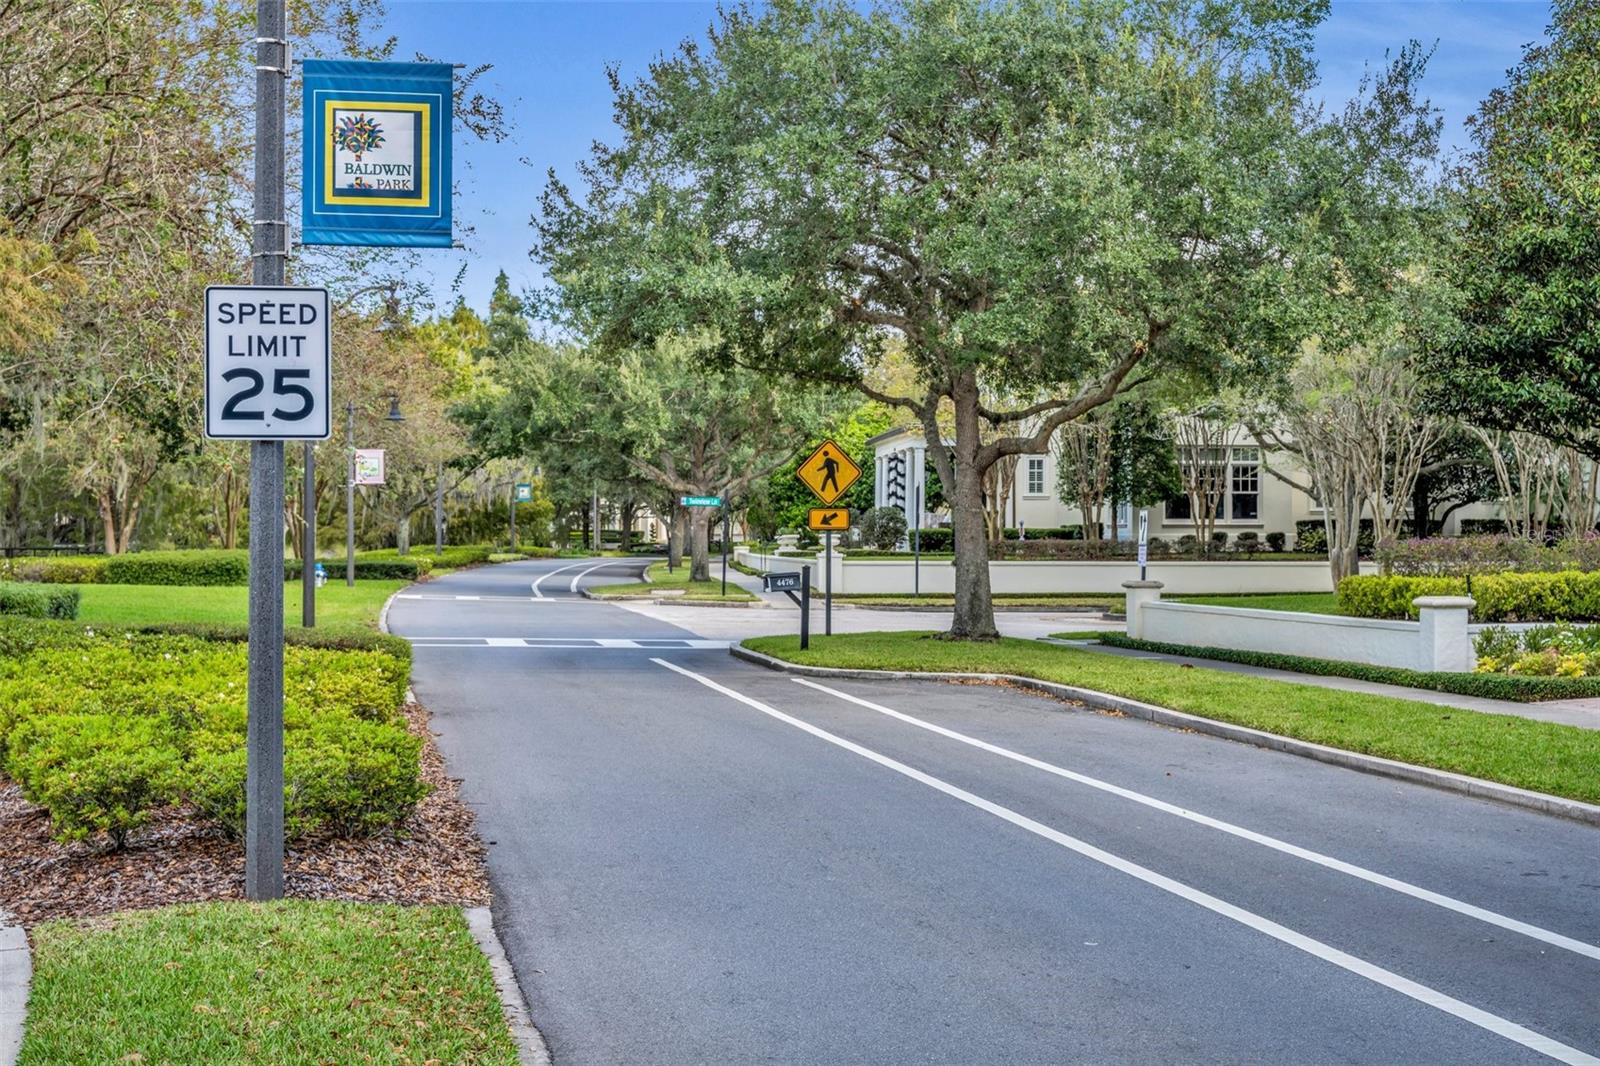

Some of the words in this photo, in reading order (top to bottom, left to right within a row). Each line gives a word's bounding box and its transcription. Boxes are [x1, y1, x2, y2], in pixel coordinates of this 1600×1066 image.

[344, 163, 412, 176] BALDWIN
[376, 178, 411, 191] PARK
[217, 302, 317, 325] SPEED
[228, 335, 306, 357] LIMIT
[221, 367, 315, 422] 25
[776, 578, 794, 586] 4476
